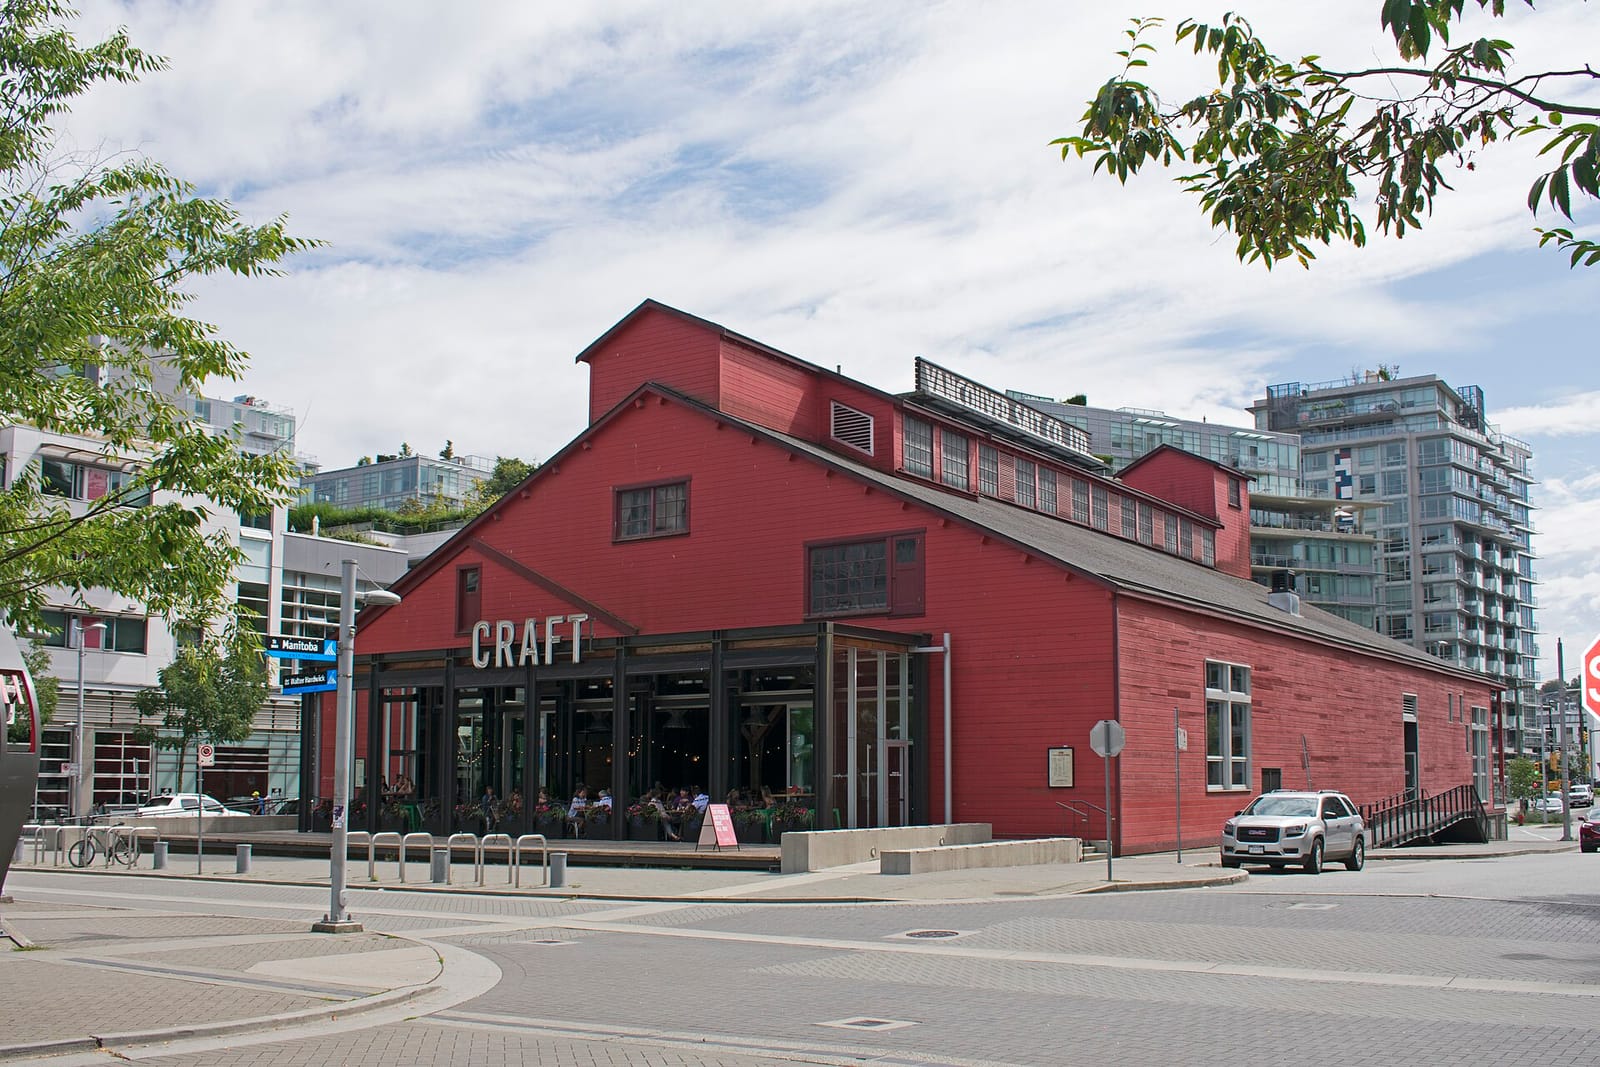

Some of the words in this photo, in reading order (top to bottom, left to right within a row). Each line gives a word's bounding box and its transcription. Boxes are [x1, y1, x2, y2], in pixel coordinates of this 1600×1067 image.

[924, 364, 1009, 422] VANCOUVER
[1015, 404, 1042, 436] SALT
[281, 639, 319, 652] Manitoba
[472, 613, 589, 669] CRAFT
